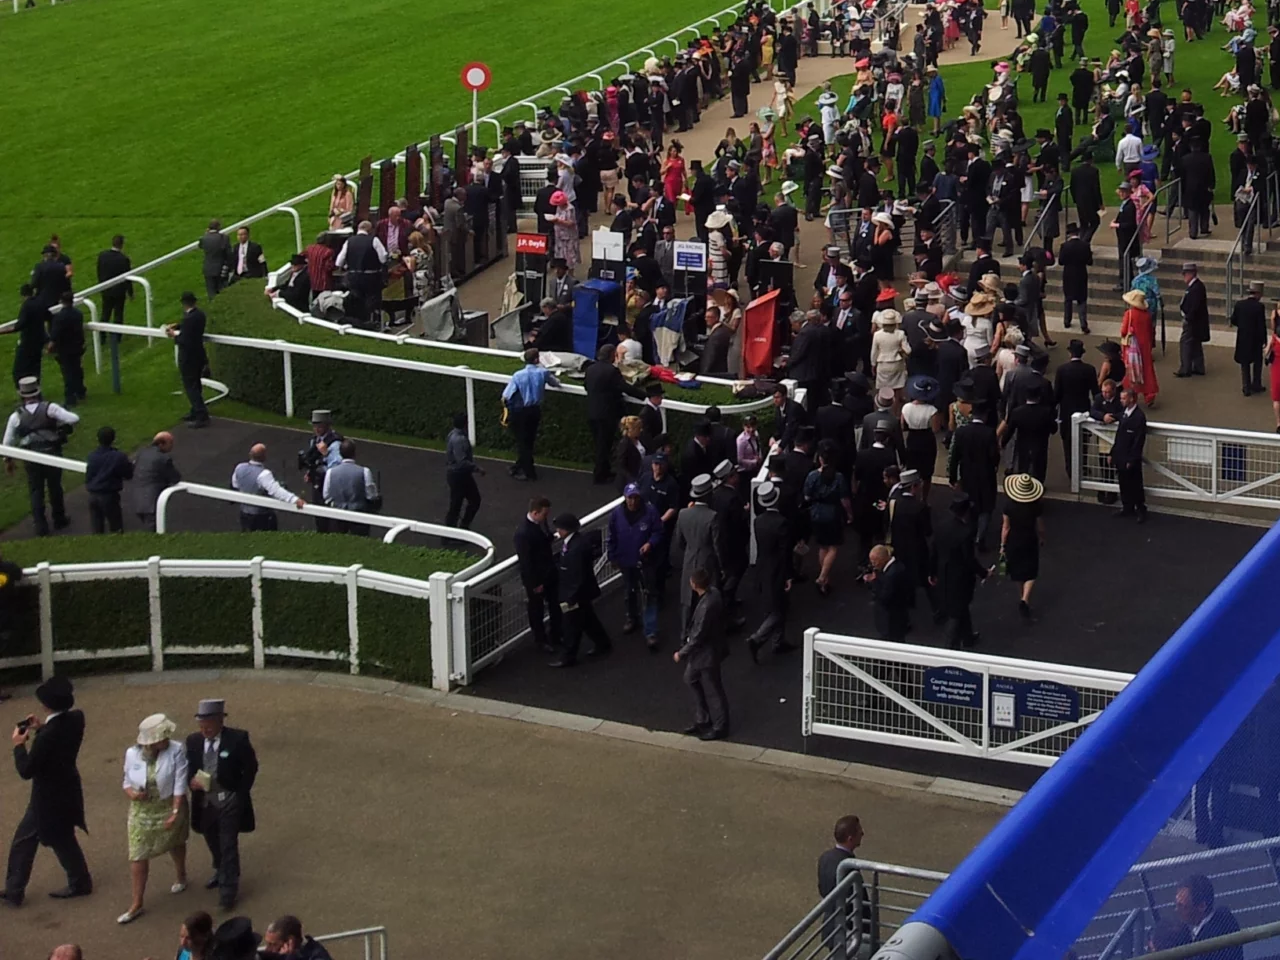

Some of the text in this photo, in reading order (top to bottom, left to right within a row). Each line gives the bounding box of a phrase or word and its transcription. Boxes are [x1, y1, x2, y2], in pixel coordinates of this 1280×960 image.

[528, 239, 545, 249] Doyle
[930, 677, 948, 686] Course
[940, 685, 975, 695] Photographers
[947, 693, 970, 701] armbands
